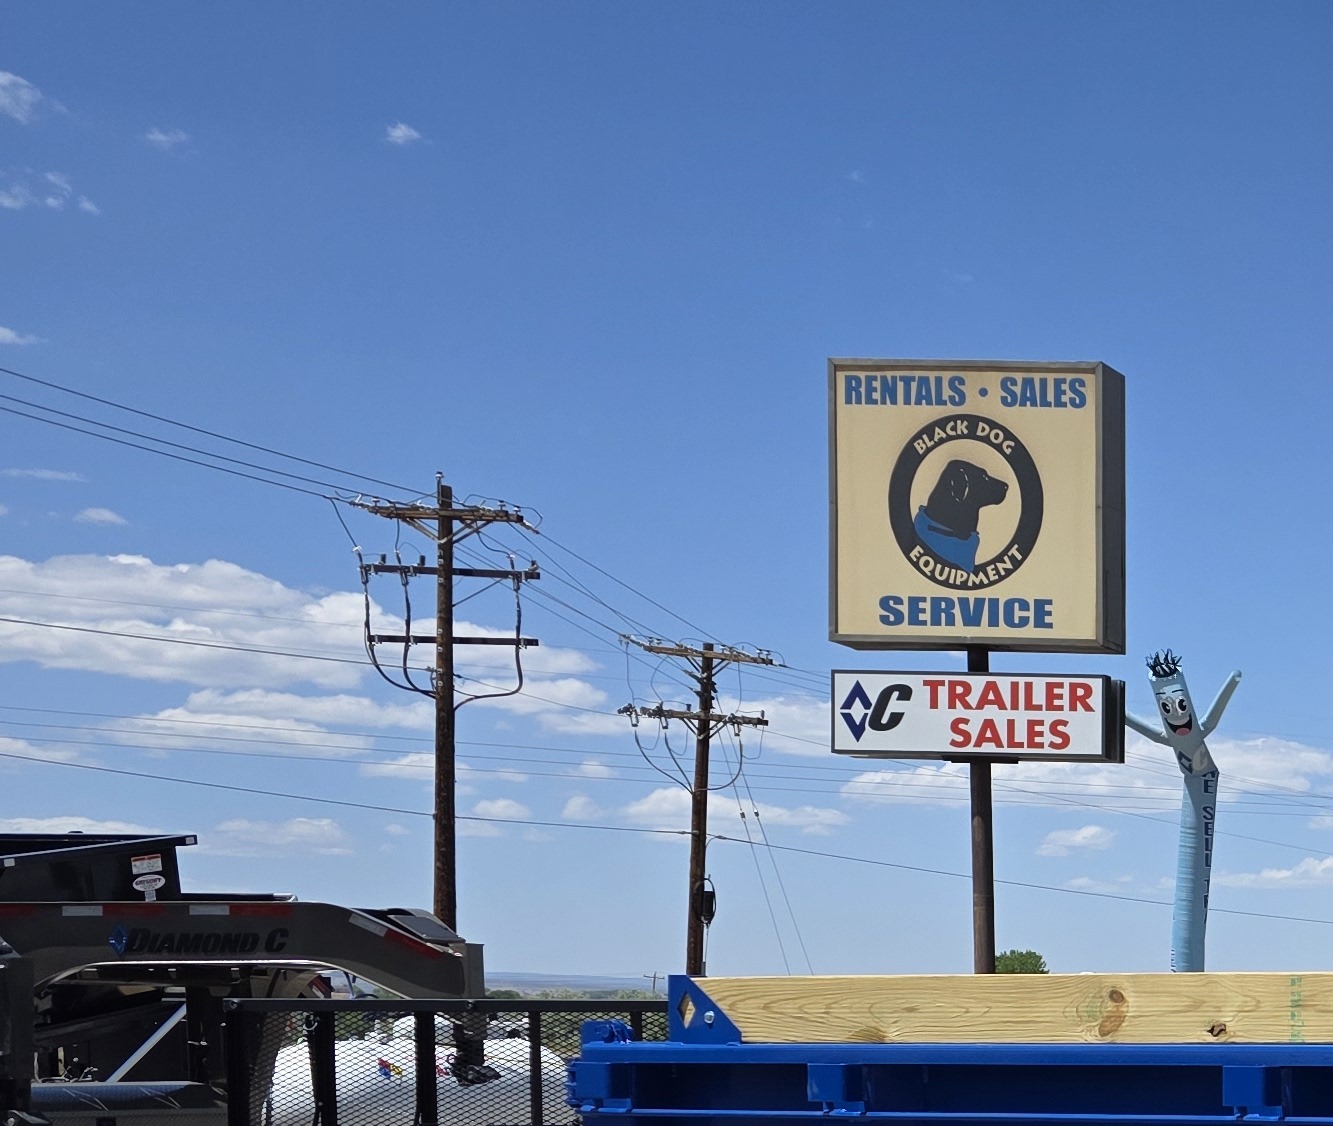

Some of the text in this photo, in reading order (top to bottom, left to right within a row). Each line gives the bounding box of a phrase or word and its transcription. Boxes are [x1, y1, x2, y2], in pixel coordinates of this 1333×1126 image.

[844, 375, 1087, 408] RENTALS SALES
[913, 419, 1015, 456] BLACK DOG
[909, 544, 1024, 587] EQUIPMENT
[878, 595, 1054, 629] SERVICE
[923, 679, 1095, 712] TRAILER
[949, 718, 1071, 750] SALES
[128, 927, 290, 954] DIAMOND C
